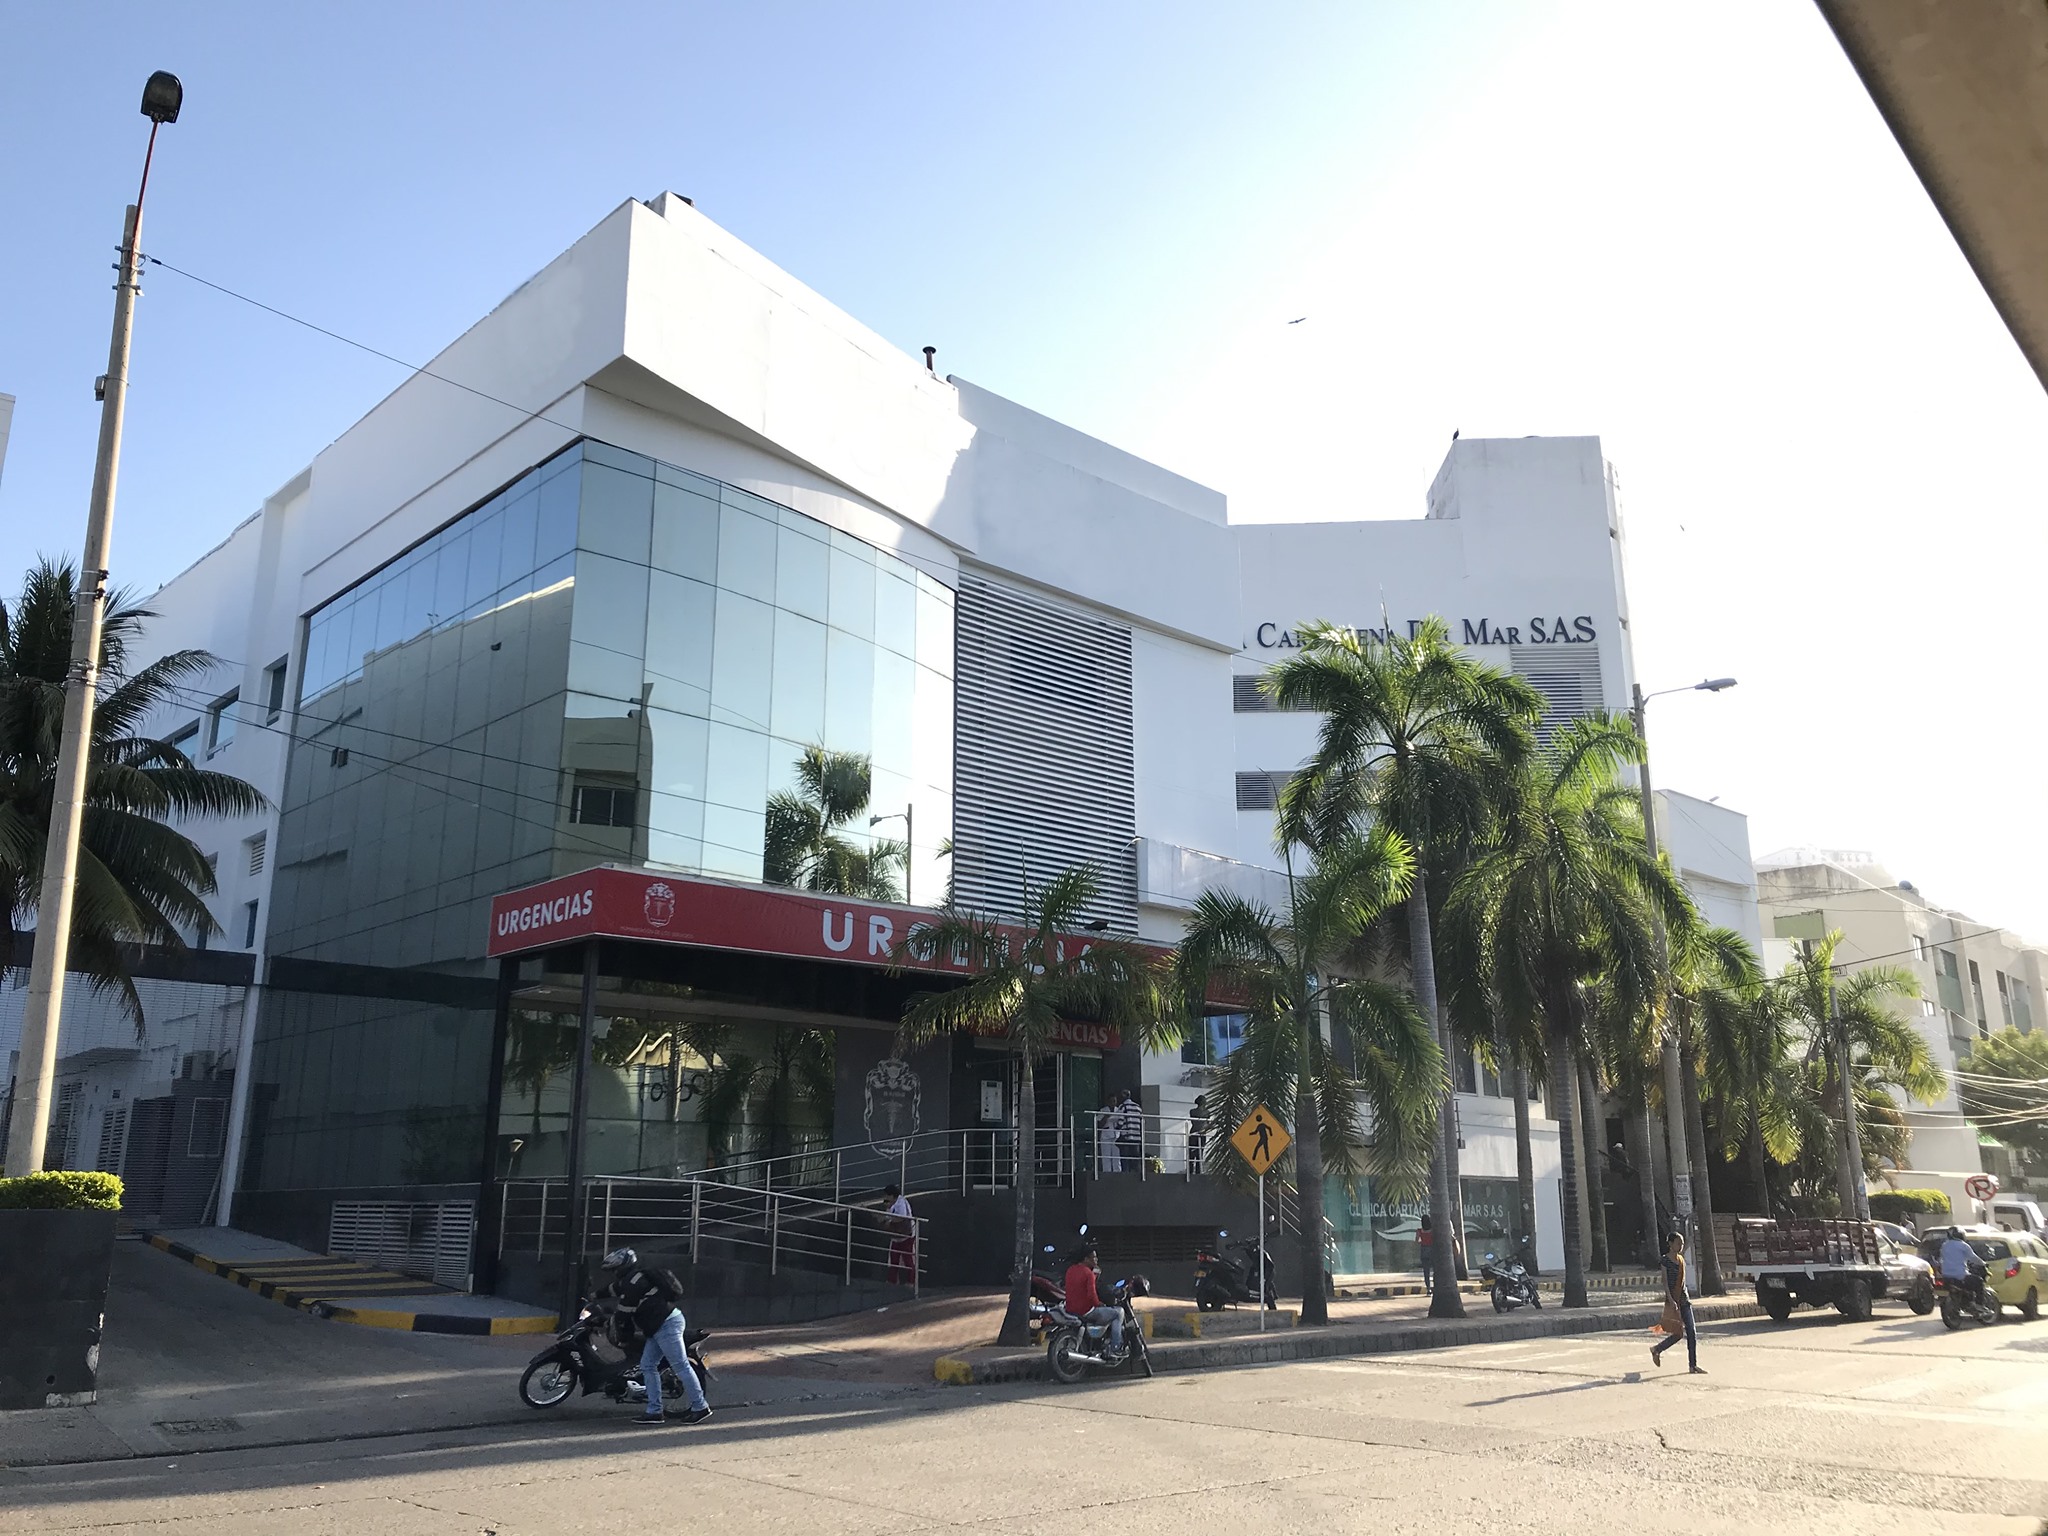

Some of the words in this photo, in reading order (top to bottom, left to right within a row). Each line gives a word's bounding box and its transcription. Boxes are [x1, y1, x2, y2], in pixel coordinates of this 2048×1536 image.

[1461, 617, 1523, 645] MAR
[1530, 615, 1597, 644] S.A.S
[497, 889, 594, 937] URGENCIAS
[822, 908, 1129, 982] URGENCI
[1046, 1021, 1109, 1044] ENCIAS
[1388, 1202, 1431, 1217] CARTAGE
[1463, 1203, 1482, 1217] MAR
